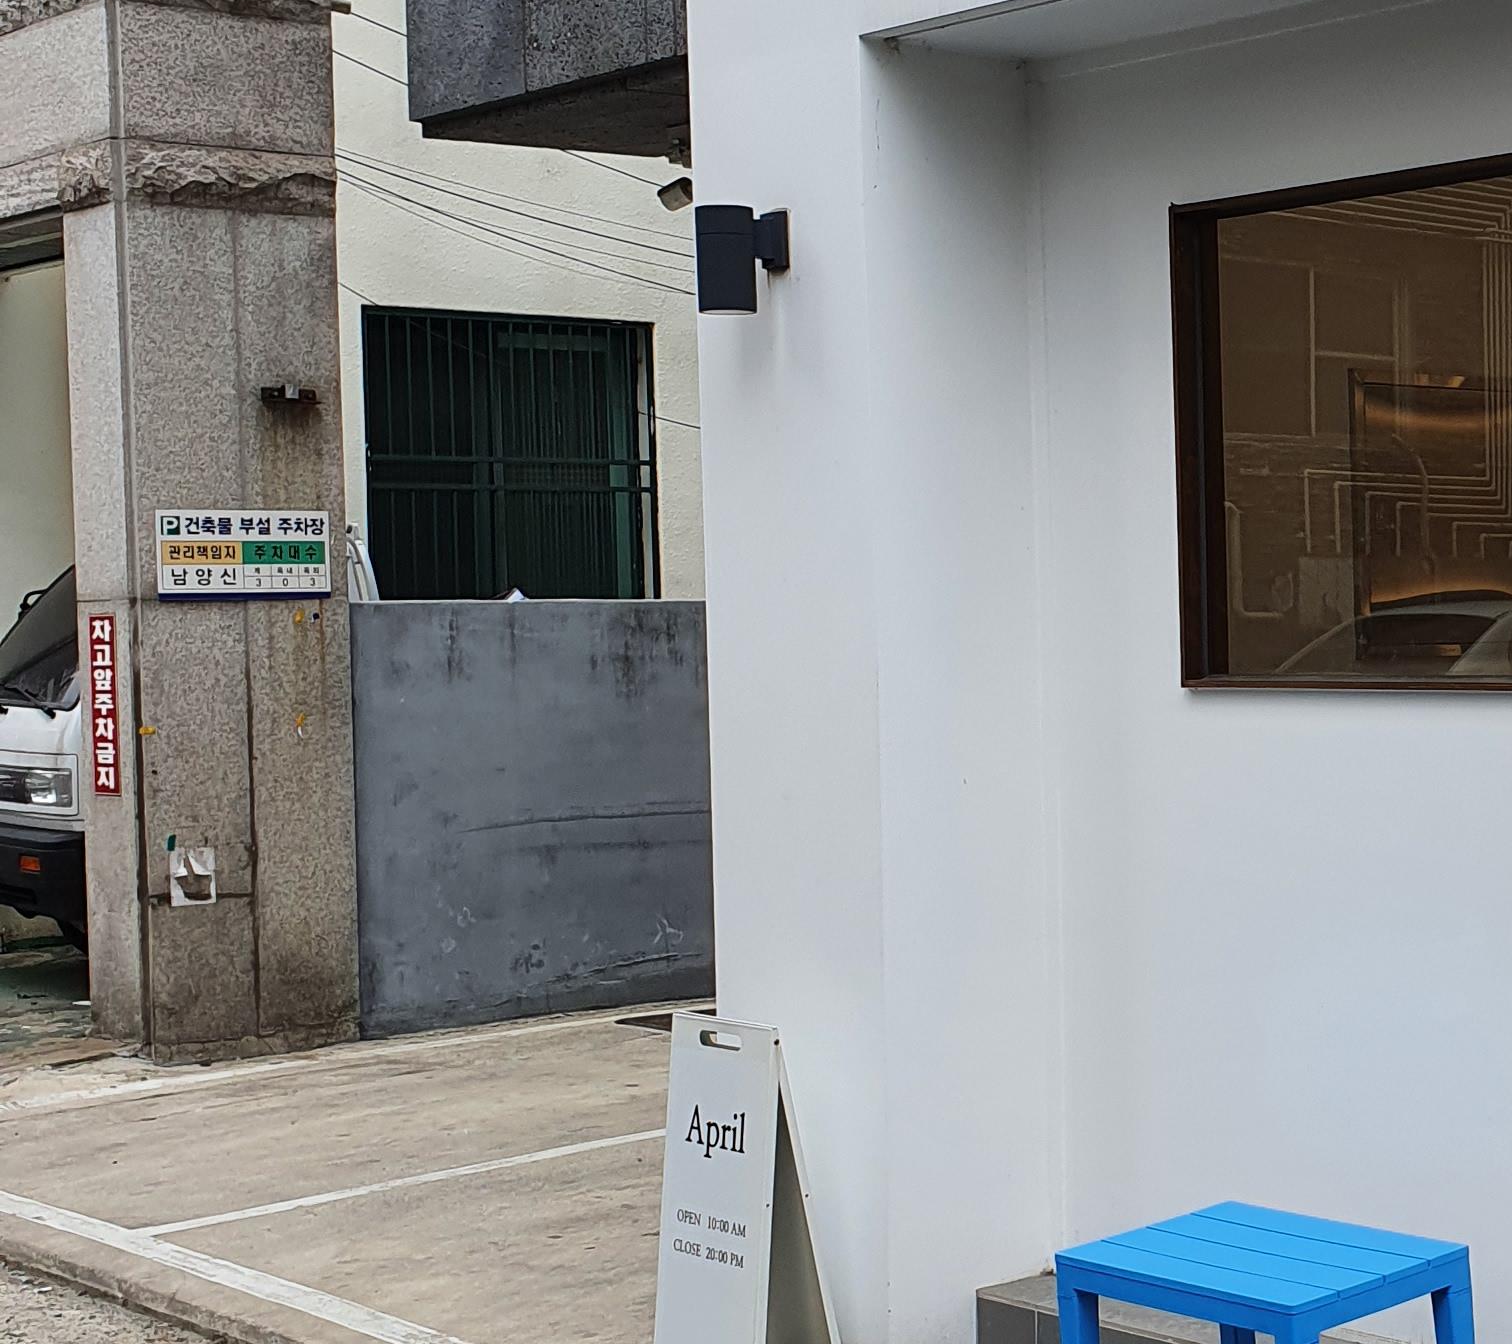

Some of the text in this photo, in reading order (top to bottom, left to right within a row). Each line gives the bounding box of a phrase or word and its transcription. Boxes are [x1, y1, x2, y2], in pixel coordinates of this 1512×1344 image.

[184, 517, 325, 536] 건축물 부설 주차장
[282, 578, 289, 587] 0
[685, 1104, 746, 1159] April
[677, 1208, 747, 1238] OPEN 10:00 AM
[673, 1238, 744, 1269] CLOSE 20:00 PM
